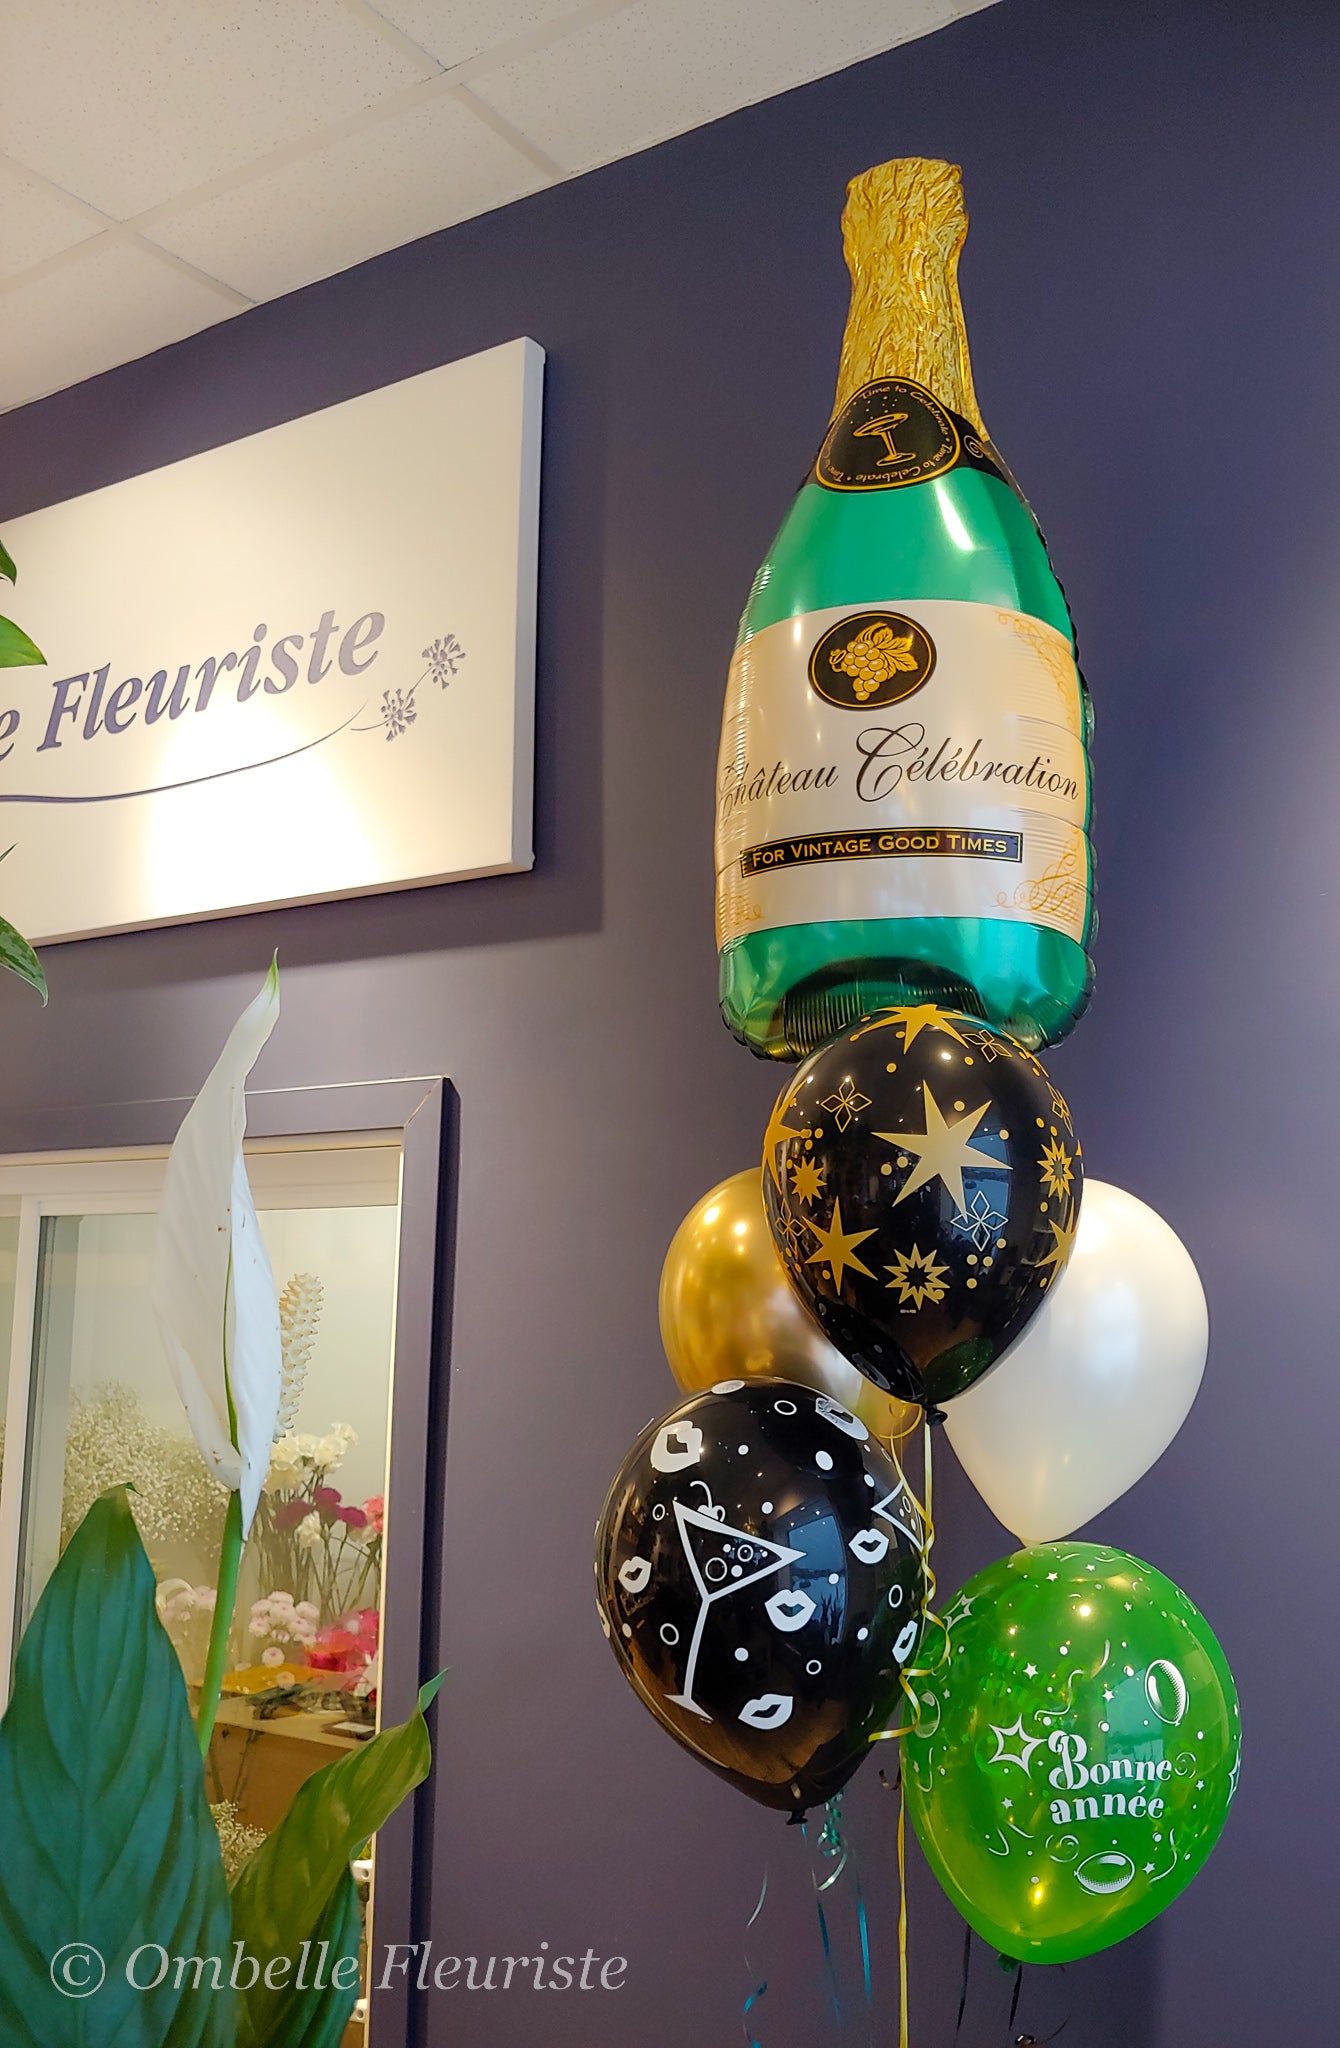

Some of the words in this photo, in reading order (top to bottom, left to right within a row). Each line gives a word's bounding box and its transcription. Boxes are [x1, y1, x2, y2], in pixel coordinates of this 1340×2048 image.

[895, 385, 907, 393] to
[36, 610, 385, 752] Fleuriste
[856, 722, 1079, 802] Célébration
[752, 850, 785, 868] FOR
[790, 838, 872, 858] VINTAGE
[878, 834, 940, 850] GOOD
[946, 834, 1008, 853] TIMES
[1048, 1730, 1172, 1790] Bonne
[1050, 1786, 1164, 1825] année
